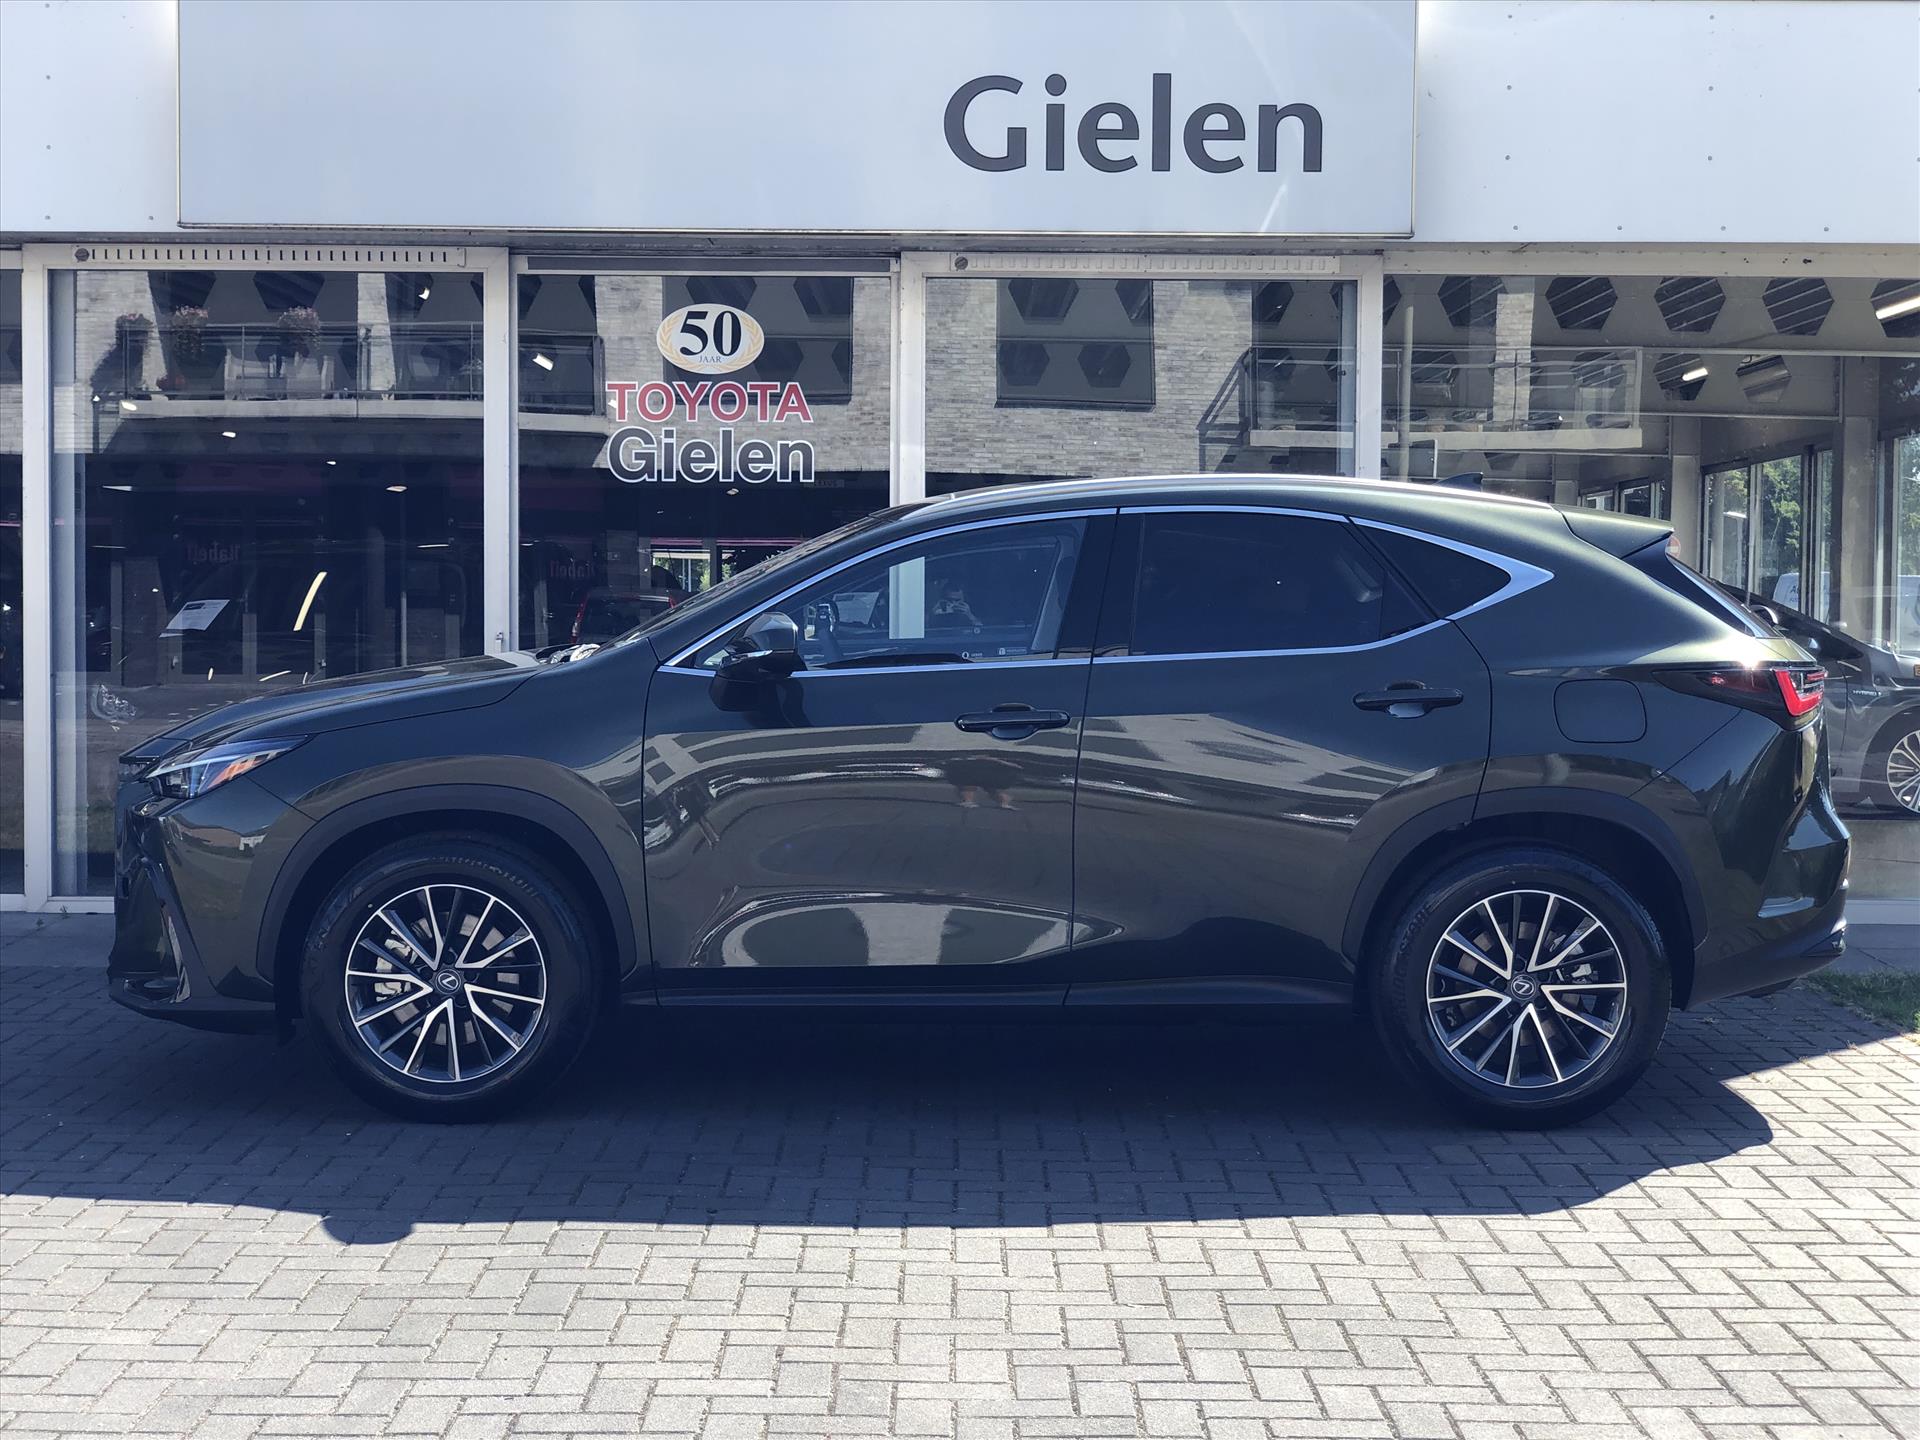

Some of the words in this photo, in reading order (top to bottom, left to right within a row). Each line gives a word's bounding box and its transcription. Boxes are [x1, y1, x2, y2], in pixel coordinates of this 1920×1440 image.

[944, 73, 1322, 173] Gielen
[680, 310, 742, 356] 50
[699, 355, 722, 364] JAAR
[606, 381, 813, 423] TOYOTA
[607, 426, 815, 483] Gielen
